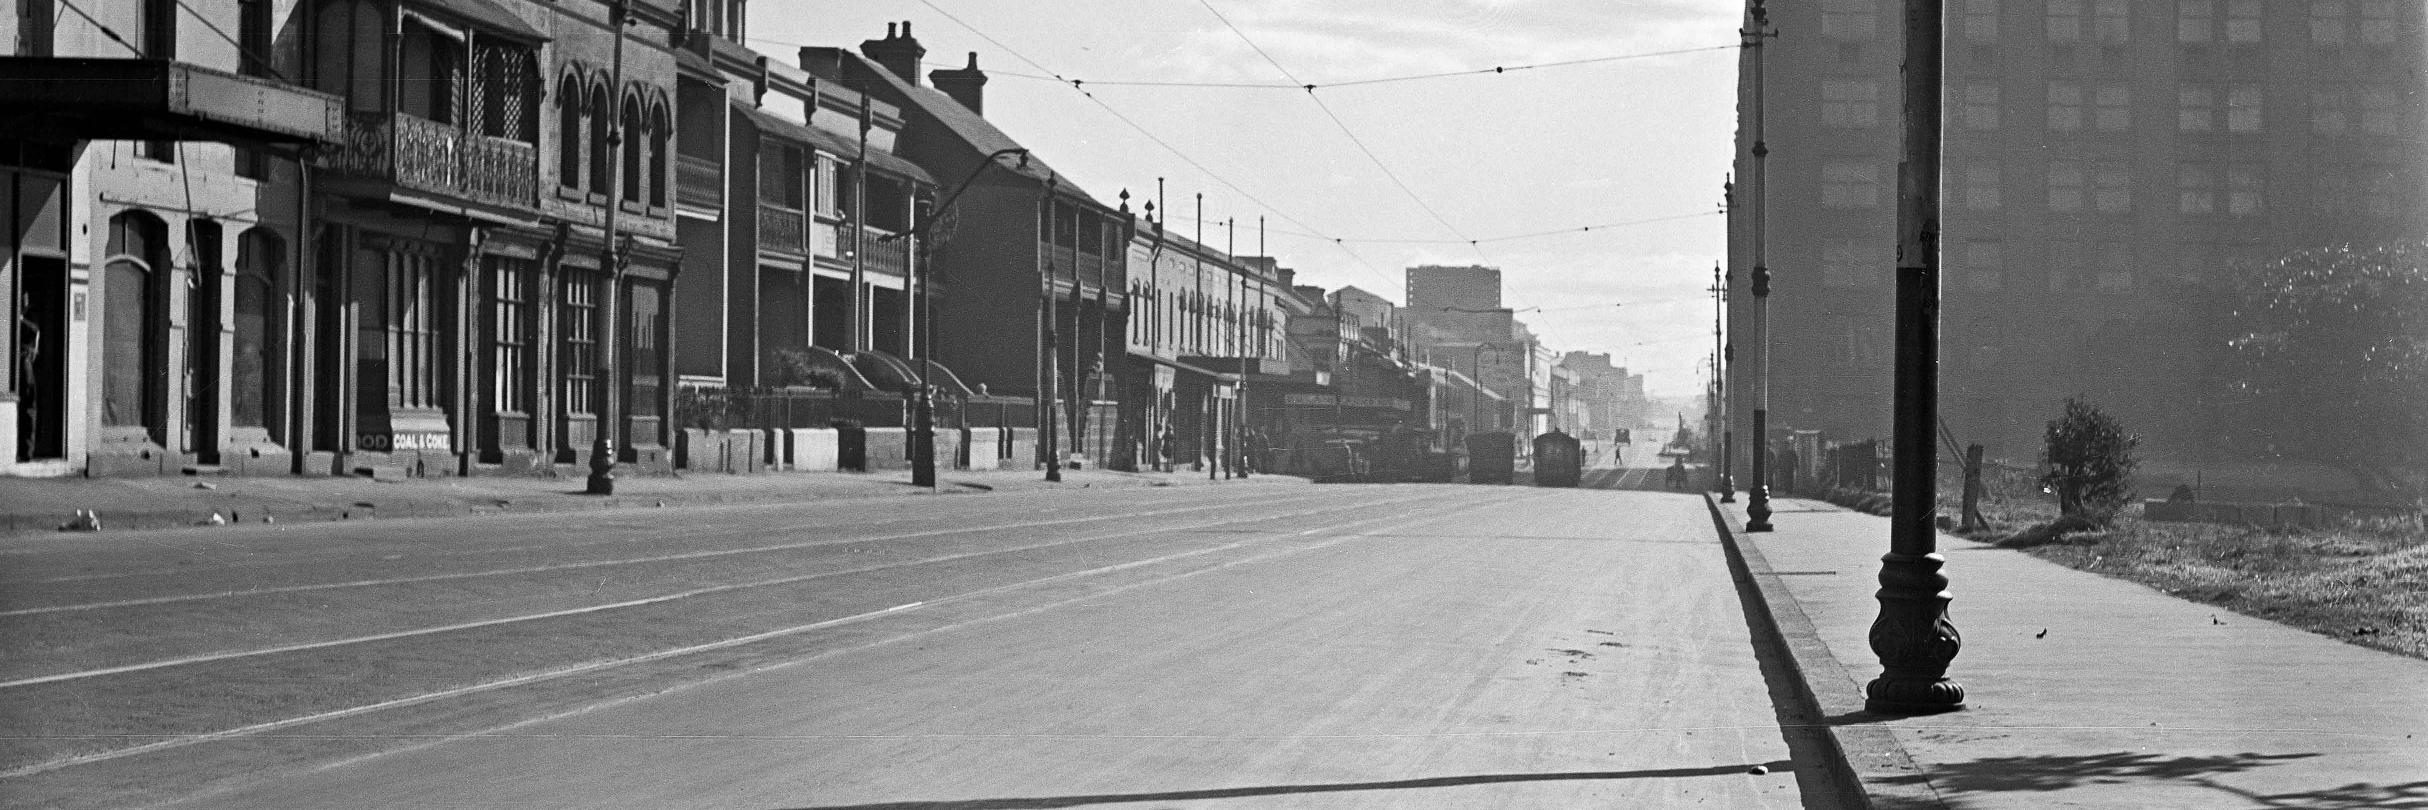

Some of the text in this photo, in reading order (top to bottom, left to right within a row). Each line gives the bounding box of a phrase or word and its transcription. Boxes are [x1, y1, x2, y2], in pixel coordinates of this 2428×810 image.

[393, 433, 418, 449] COAL
[419, 434, 425, 449] &
[426, 433, 448, 449] COKE
